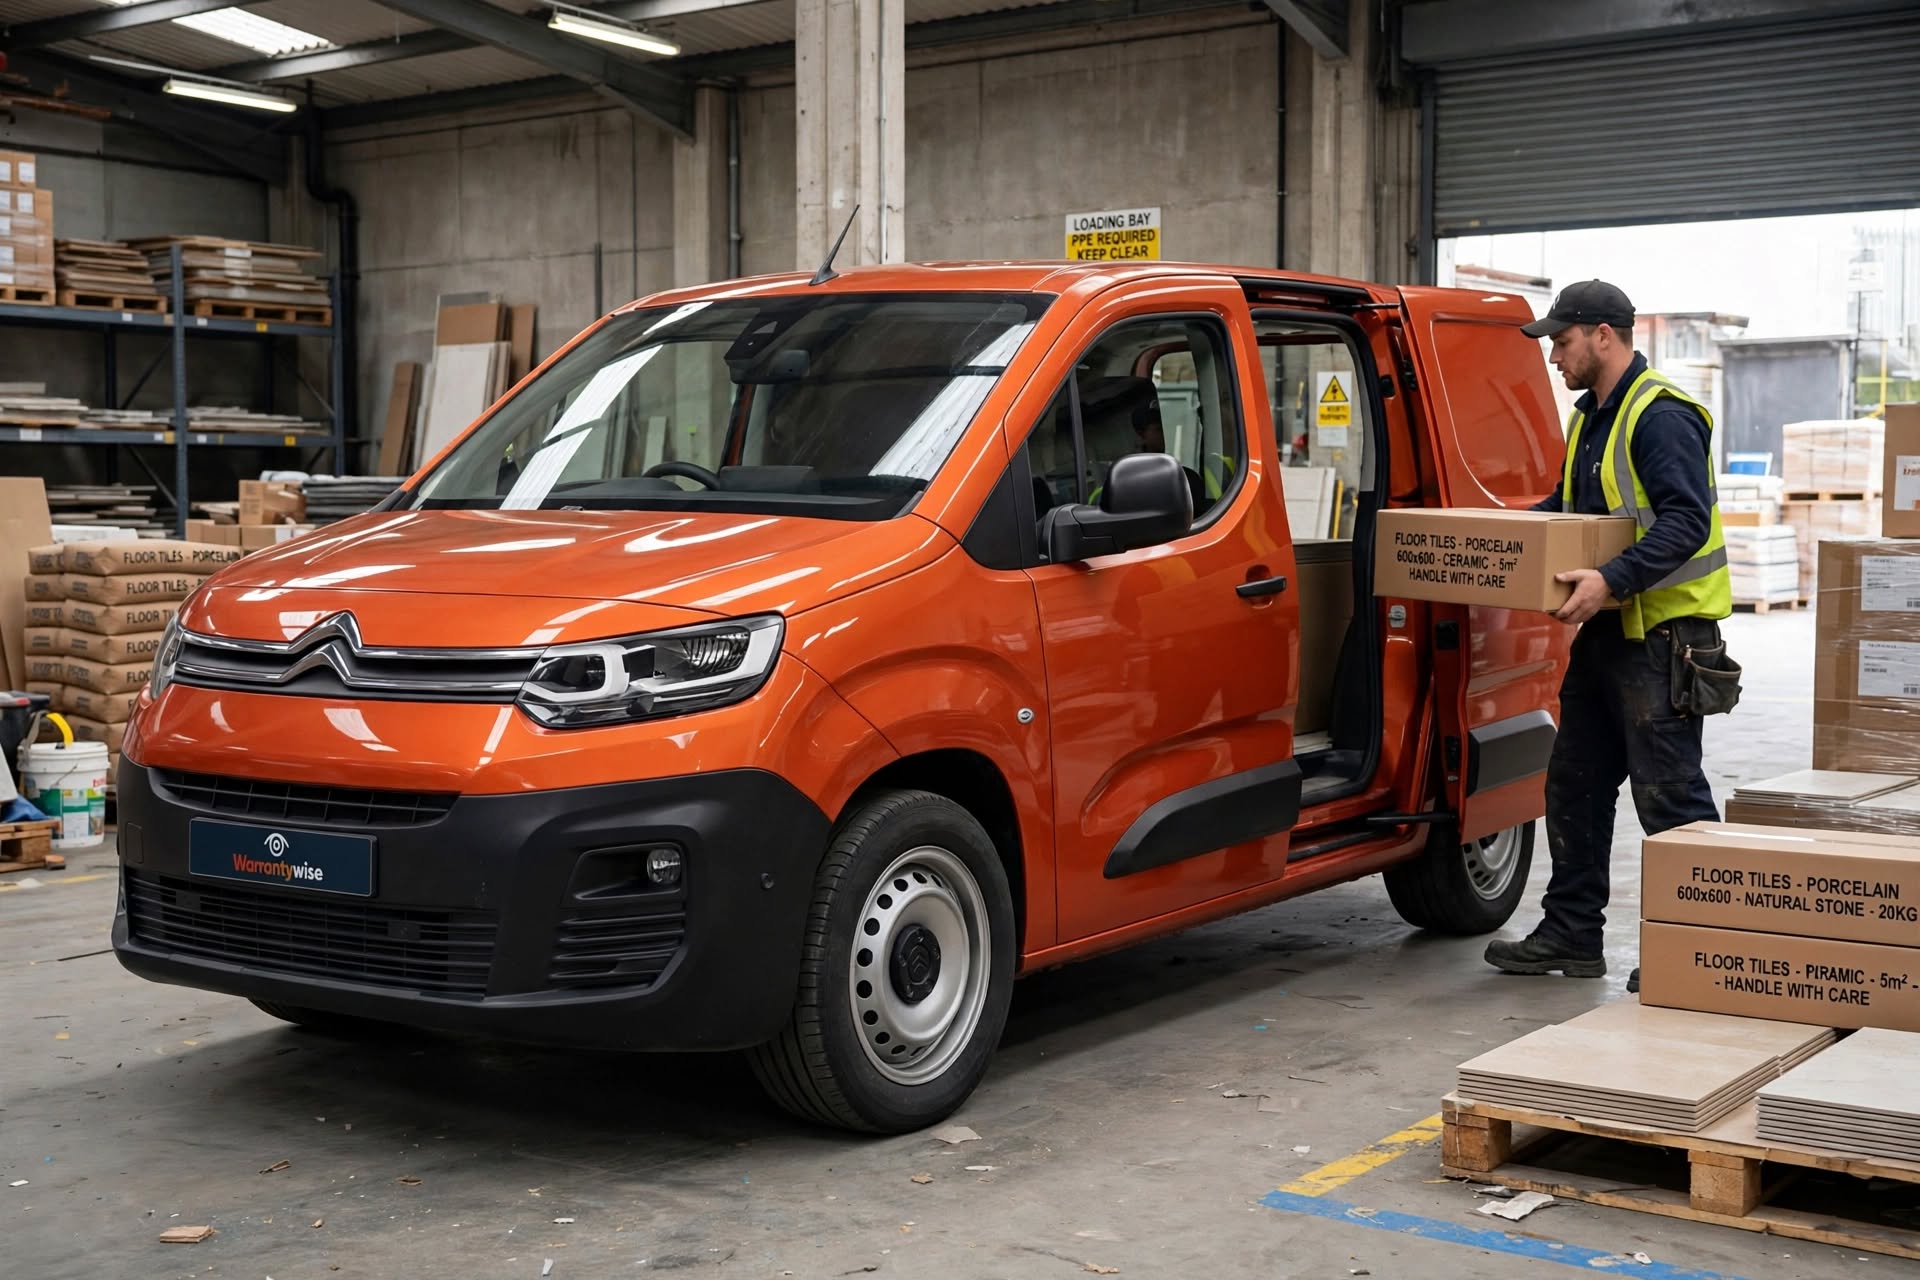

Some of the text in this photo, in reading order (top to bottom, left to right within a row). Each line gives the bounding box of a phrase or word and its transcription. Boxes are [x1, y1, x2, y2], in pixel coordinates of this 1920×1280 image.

[1073, 212, 1151, 231] LOADING BAY
[1071, 229, 1155, 246] PPE REQUIRED
[1077, 245, 1149, 260] KEEP CLEAR
[1394, 532, 1427, 547] FLOOR
[1429, 534, 1456, 550] TILES
[1465, 537, 1524, 554] PORCELAIN
[124, 551, 157, 564] FLOOR
[158, 549, 183, 562] TILES
[1396, 550, 1436, 565] 600x600
[1443, 552, 1489, 570] CERAMIC
[1499, 557, 1518, 572] 5m²
[126, 581, 160, 594] FLOOR
[162, 578, 188, 592] TILES
[1409, 567, 1506, 588] HANDLE WITH CARE
[126, 610, 160, 624] FLOOR
[232, 853, 324, 882] Warrantywise
[1692, 867, 1744, 886] FLOOR
[1748, 871, 1791, 890] TILES
[1807, 876, 1899, 900] PORCELAIN
[1677, 885, 1731, 904] 600x600
[1744, 891, 1811, 912] NATURAL
[1815, 898, 1865, 917] STONE
[1878, 903, 1918, 922] 20KG
[1695, 951, 1744, 972] FLOOR
[1749, 957, 1790, 977] TILES
[1805, 963, 1865, 985] PIRAMIC
[1879, 972, 1908, 991] 5m²
[1724, 975, 1783, 996] HANDLE
[1787, 982, 1824, 1001] WITH
[1828, 987, 1870, 1006] CARE
